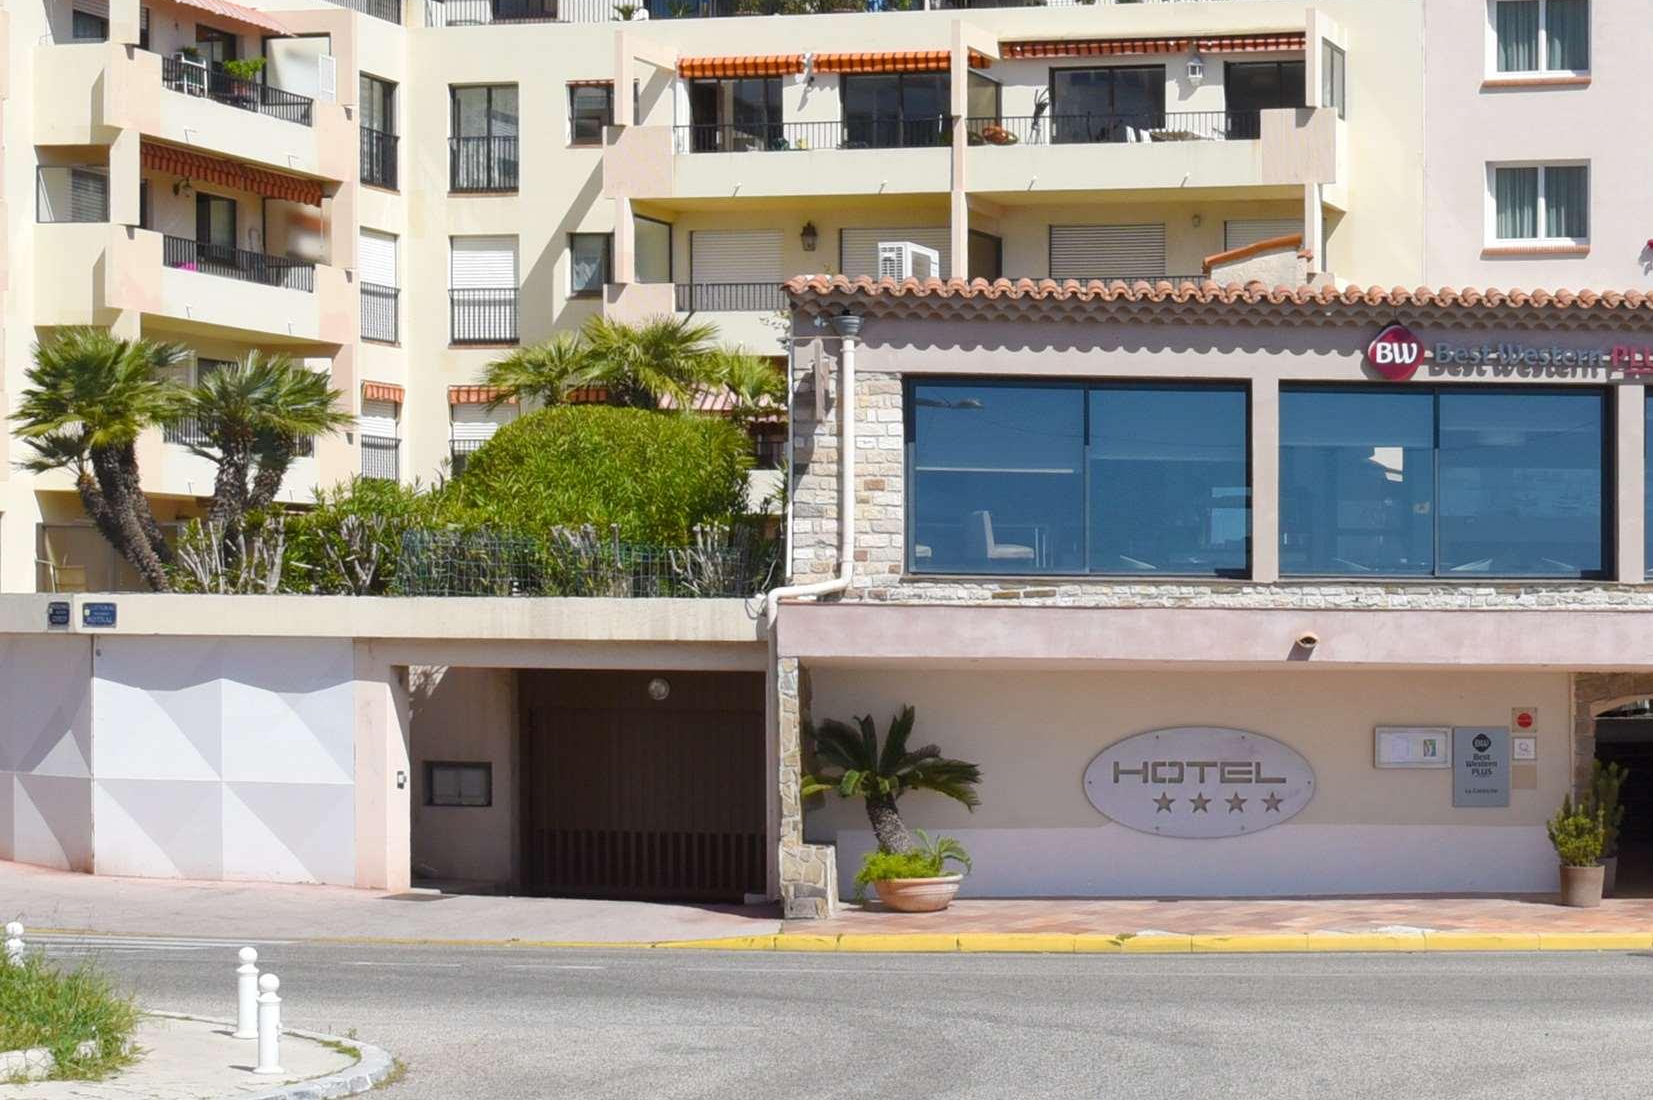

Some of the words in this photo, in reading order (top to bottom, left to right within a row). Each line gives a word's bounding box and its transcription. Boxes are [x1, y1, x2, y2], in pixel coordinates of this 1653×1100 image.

[1375, 342, 1418, 365] BW
[1434, 342, 1493, 365] Best
[1498, 342, 1606, 367] Western
[1473, 753, 1491, 761] Best
[1112, 761, 1287, 784] HOTEL
